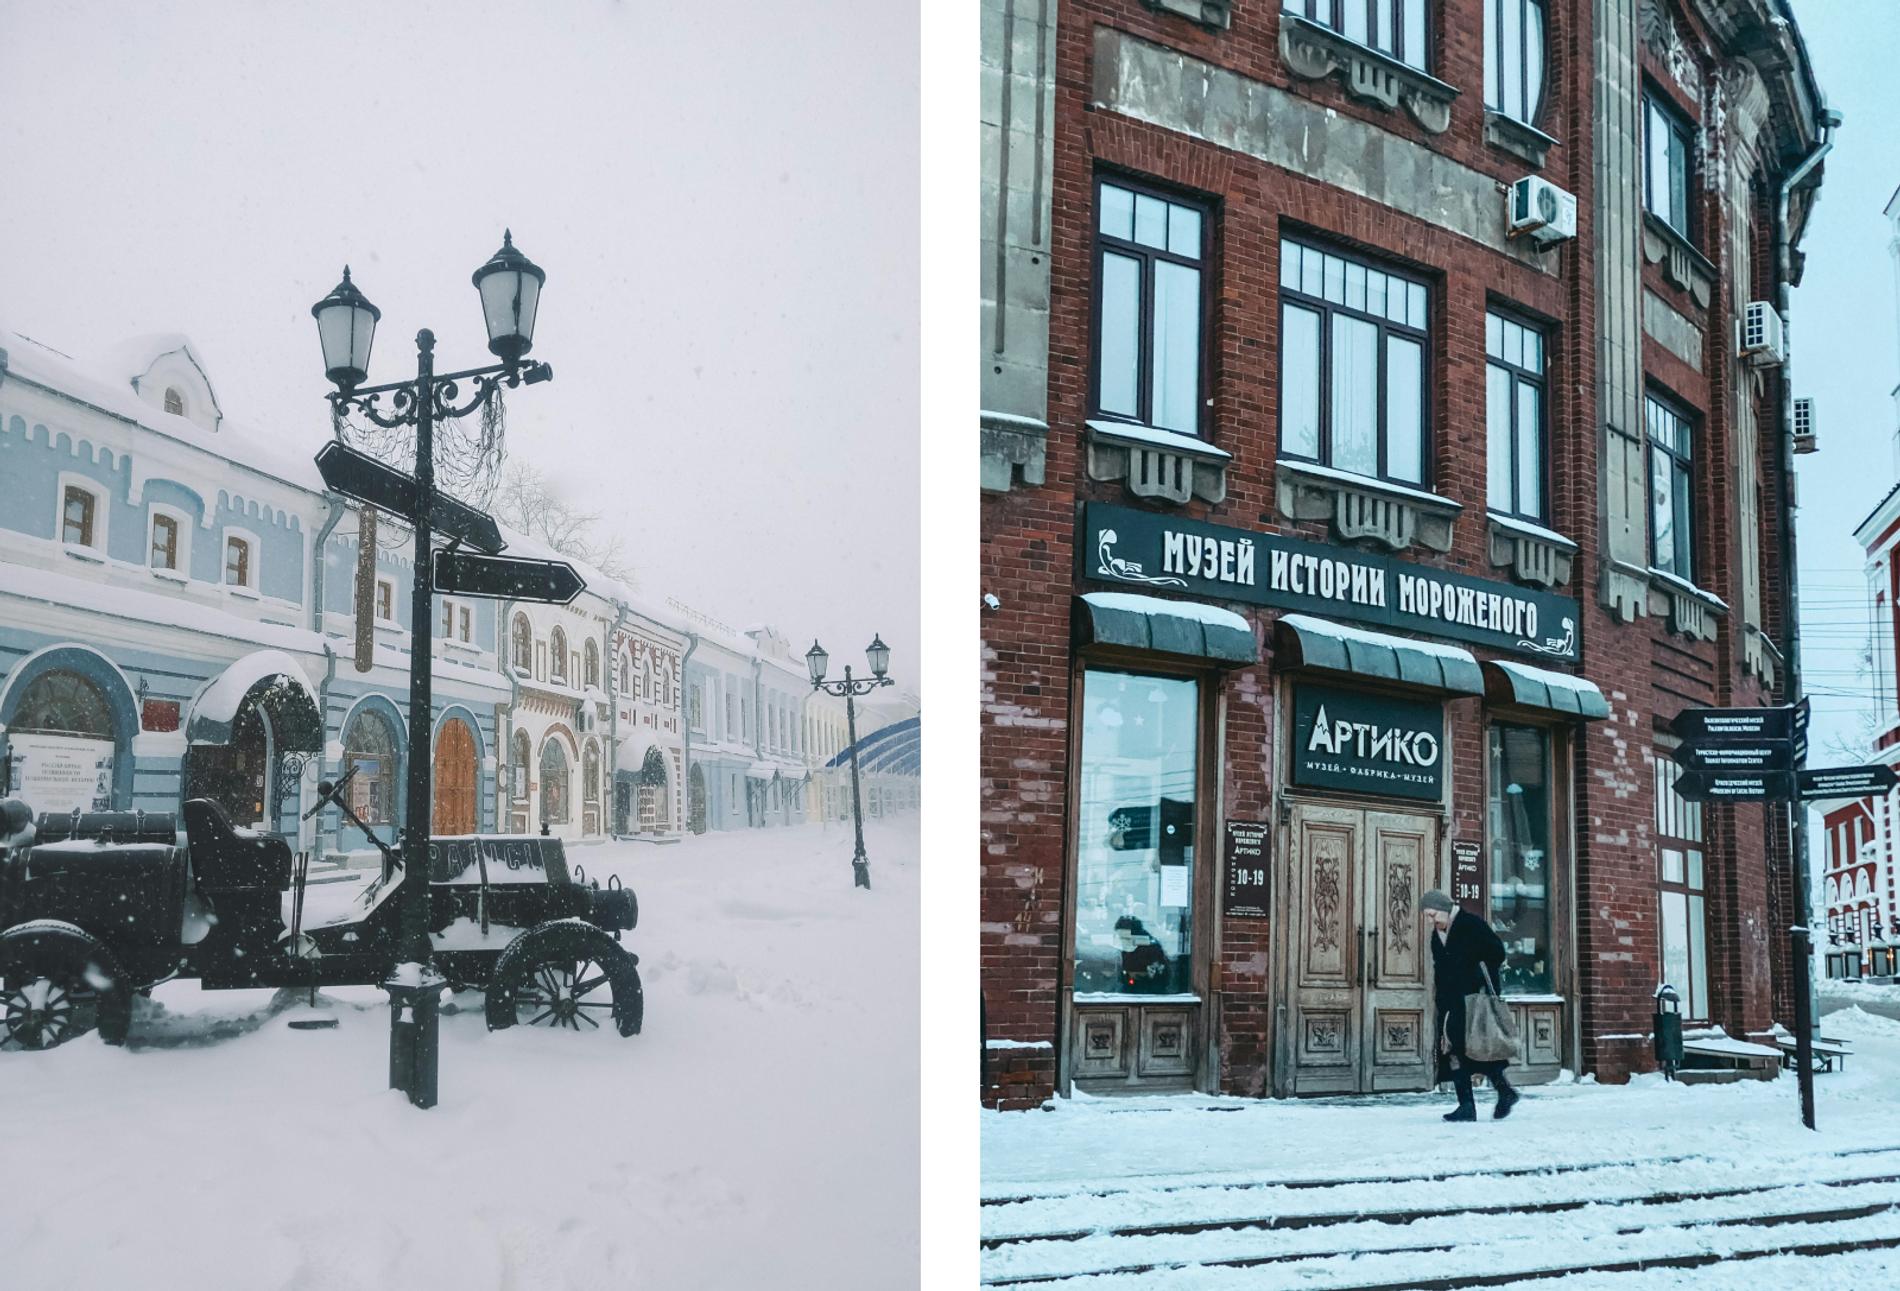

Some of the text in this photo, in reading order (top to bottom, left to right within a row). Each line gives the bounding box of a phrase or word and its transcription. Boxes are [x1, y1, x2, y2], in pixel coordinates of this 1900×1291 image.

[1163, 530, 1538, 639] МУЗЕЙ ИСТОРИИ МОРОЖЕНОГО
[1308, 703, 1438, 767] АРТИКО
[1306, 761, 1434, 784] МУЗЕЙ ФАБРИКА МУЗЕЙ
[1237, 868, 1263, 885] 10-19
